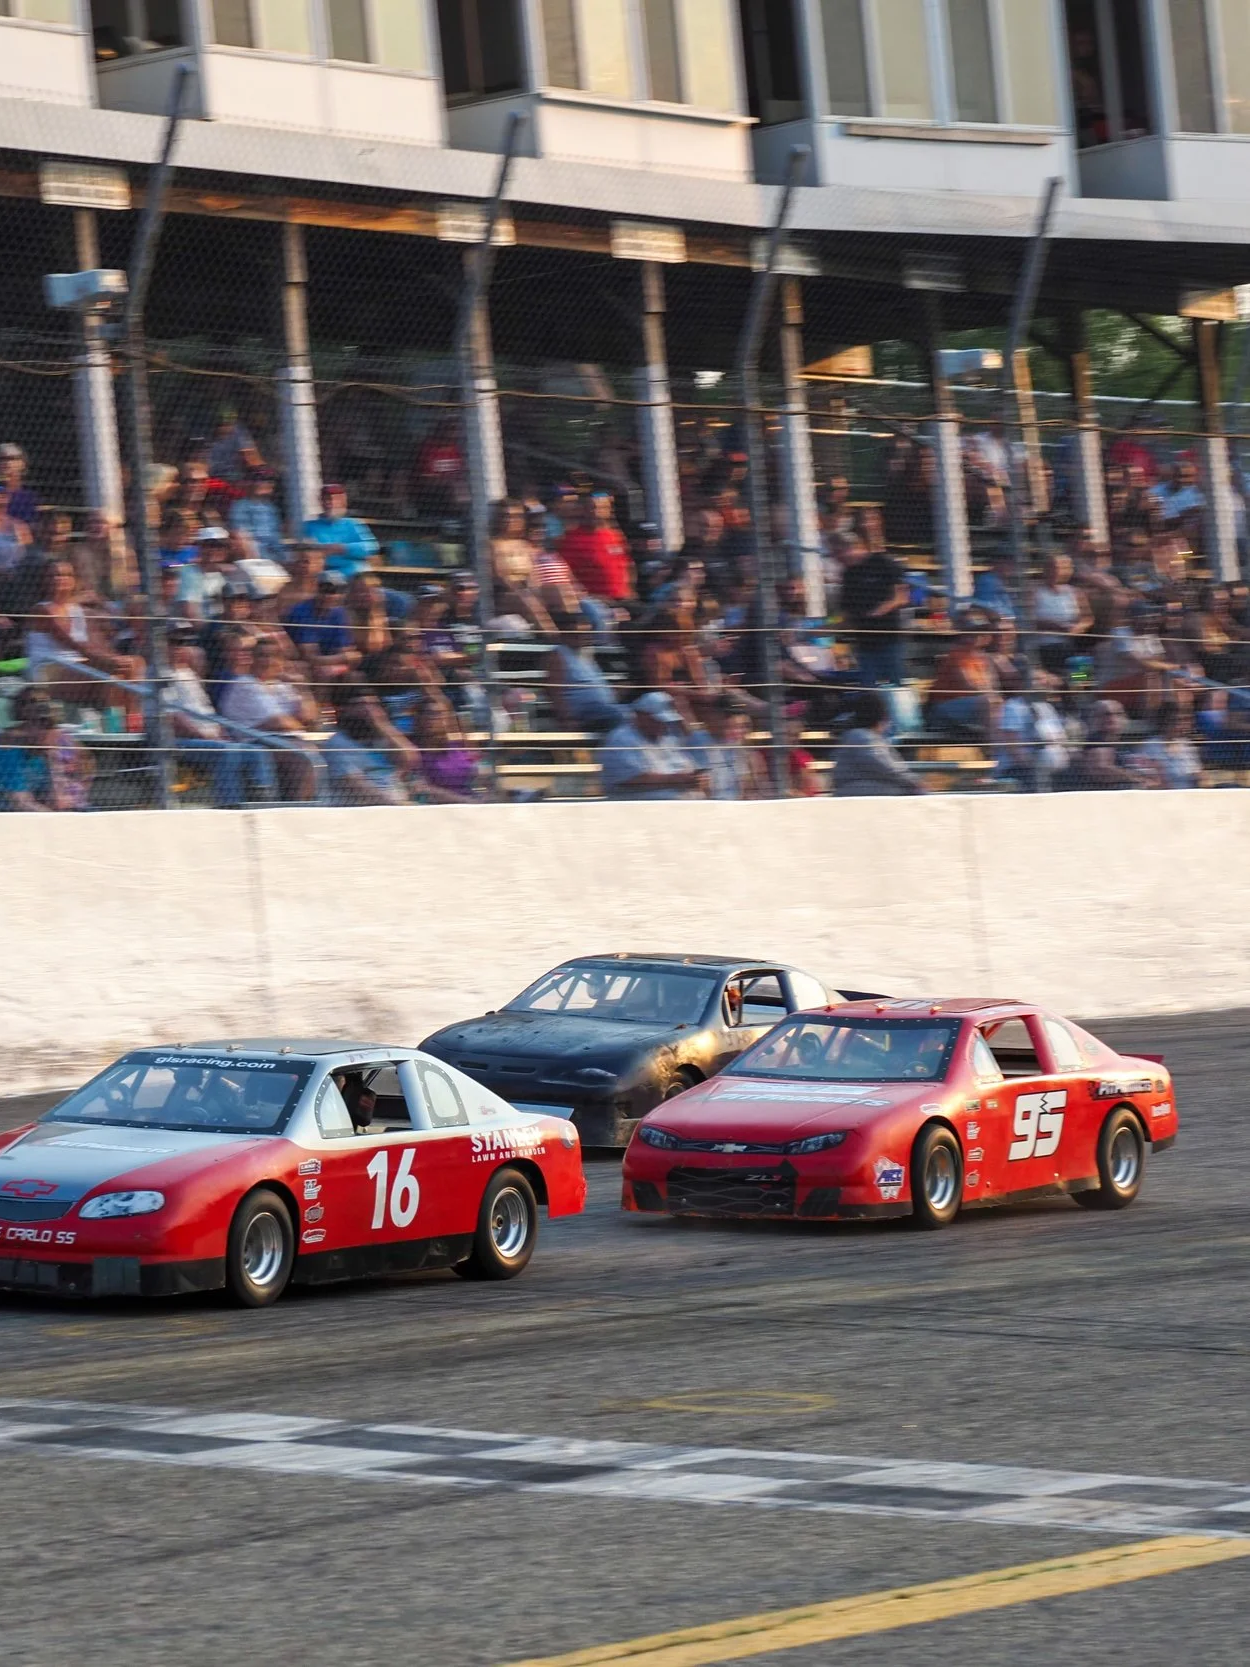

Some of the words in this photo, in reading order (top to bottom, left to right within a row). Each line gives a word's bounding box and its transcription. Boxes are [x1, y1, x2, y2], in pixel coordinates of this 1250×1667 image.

[1007, 1089, 1067, 1162] 95
[472, 1127, 542, 1152] STANLEY
[472, 1154, 495, 1163] LAWN
[499, 1151, 516, 1159] AND
[519, 1147, 546, 1157] GARDEN
[366, 1148, 420, 1229] 16
[5, 1228, 52, 1243] CARLO
[54, 1232, 77, 1245] SS
